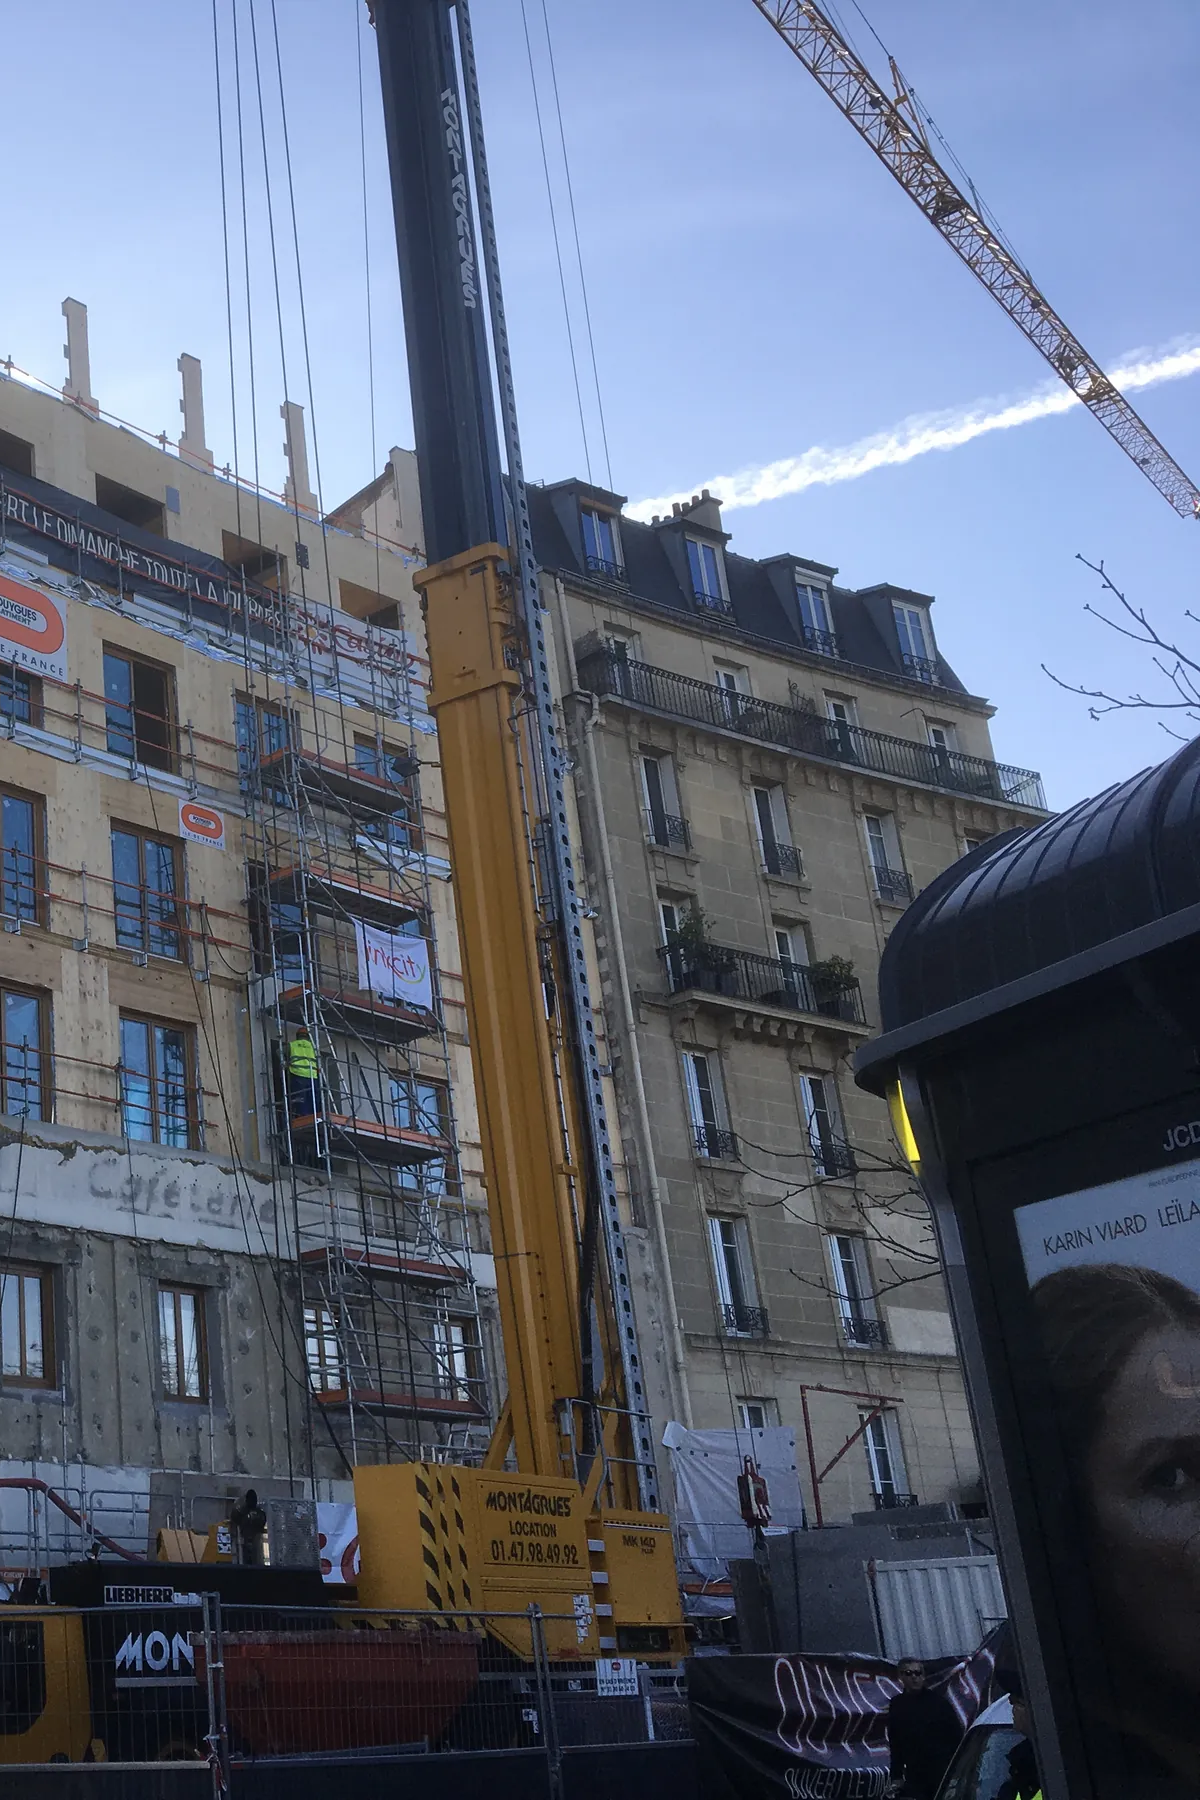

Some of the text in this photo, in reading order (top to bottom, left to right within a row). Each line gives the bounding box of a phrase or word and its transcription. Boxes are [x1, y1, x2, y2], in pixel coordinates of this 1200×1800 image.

[56, 517, 140, 569] DIMANCHE
[142, 556, 193, 591] TOUTE
[1043, 1197, 1200, 1256] KARIN VIARD LEÏLA
[486, 1489, 572, 1517] MONTAGRUES
[508, 1520, 557, 1538] LOCATION
[622, 1534, 656, 1549] MK 140
[490, 1539, 579, 1565] 01.47.98.49.92
[105, 1587, 173, 1603] LIEBHERR
[115, 1631, 194, 1671] MON
[774, 1657, 904, 1753] OUVER
[784, 1767, 845, 1800] OUVERT
[847, 1767, 865, 1798] LE
